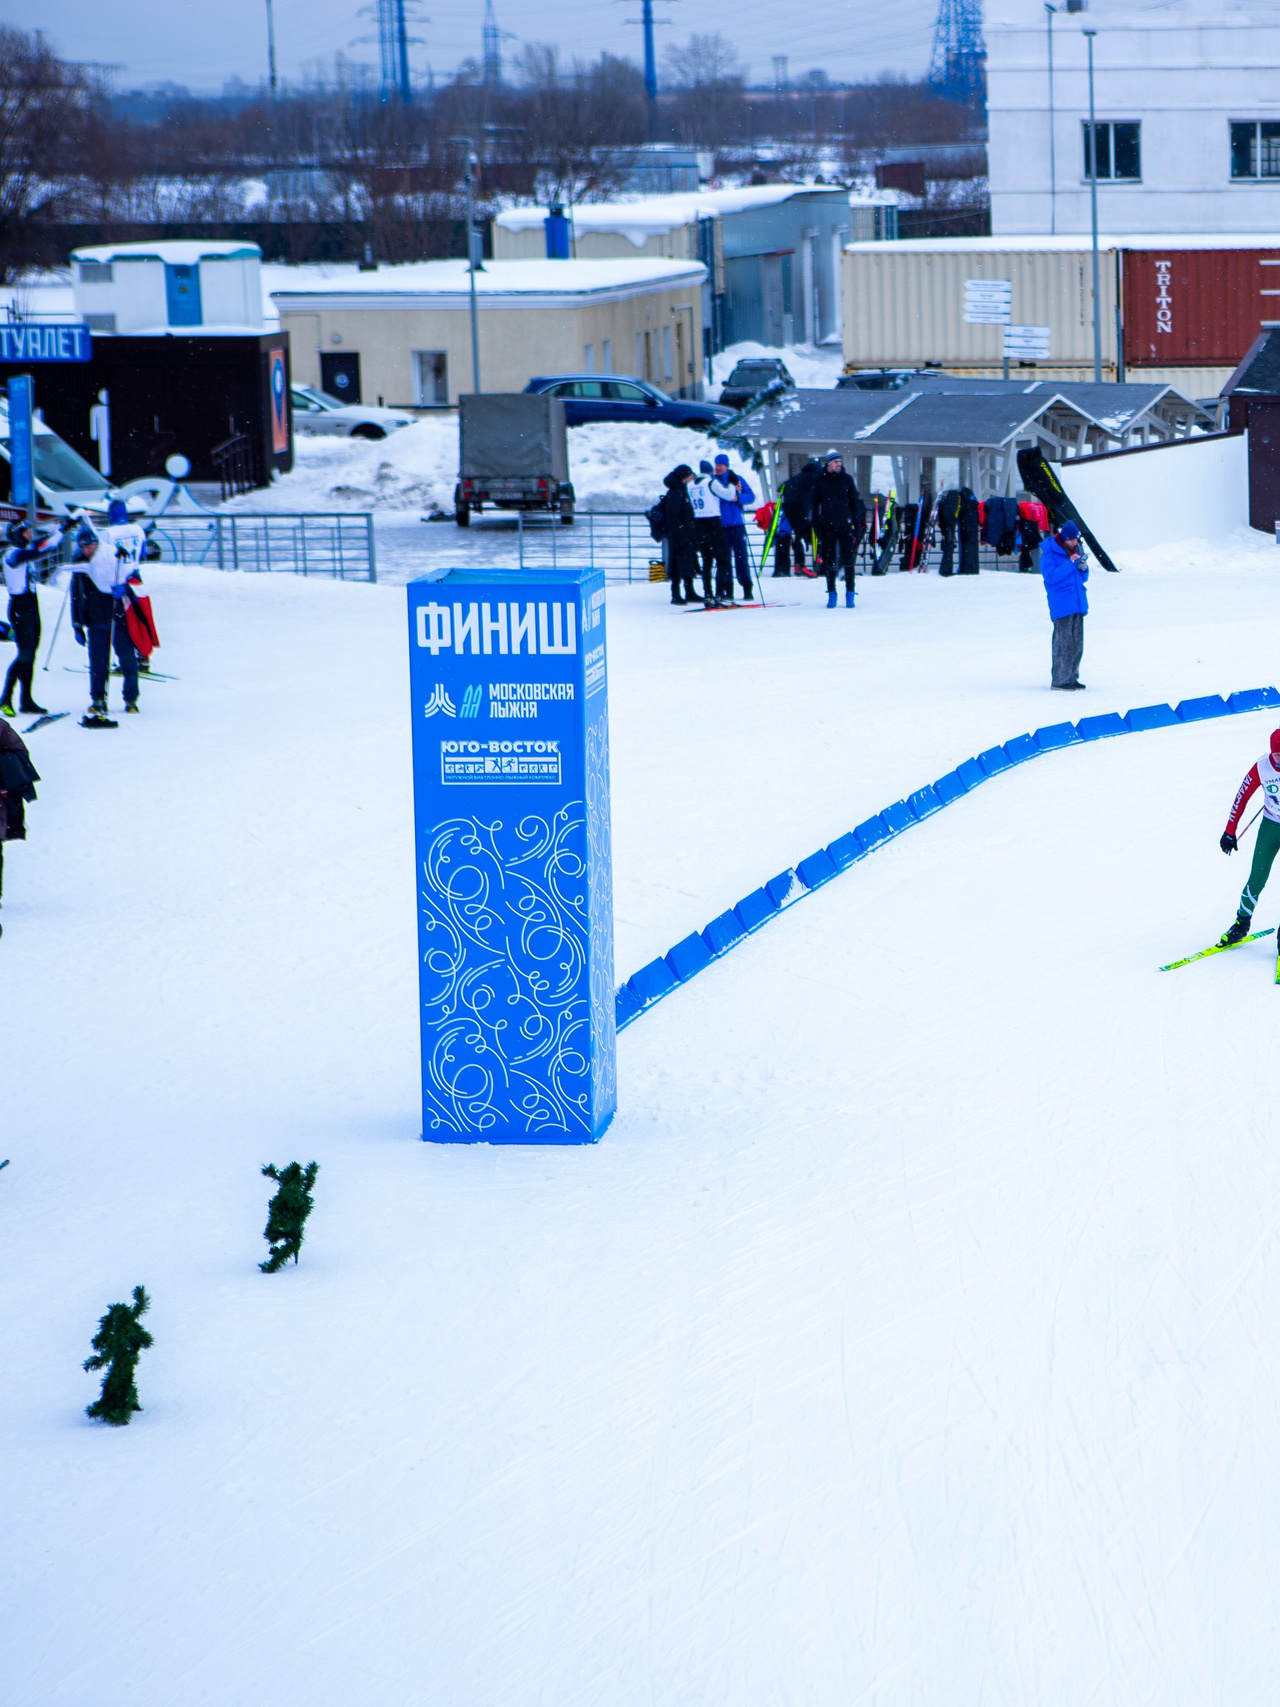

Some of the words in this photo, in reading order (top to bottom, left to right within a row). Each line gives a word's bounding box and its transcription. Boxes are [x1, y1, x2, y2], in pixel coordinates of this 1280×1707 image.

[1155, 261, 1173, 333] TRITON
[0, 328, 82, 358] ТУАЛЕТ
[416, 602, 577, 655] ФИНИШ
[489, 683, 574, 700] МОСКОВСКАЯ
[489, 701, 538, 718] ЛЫЖНЯ
[441, 741, 560, 753] ЮГО-ВОСТОК
